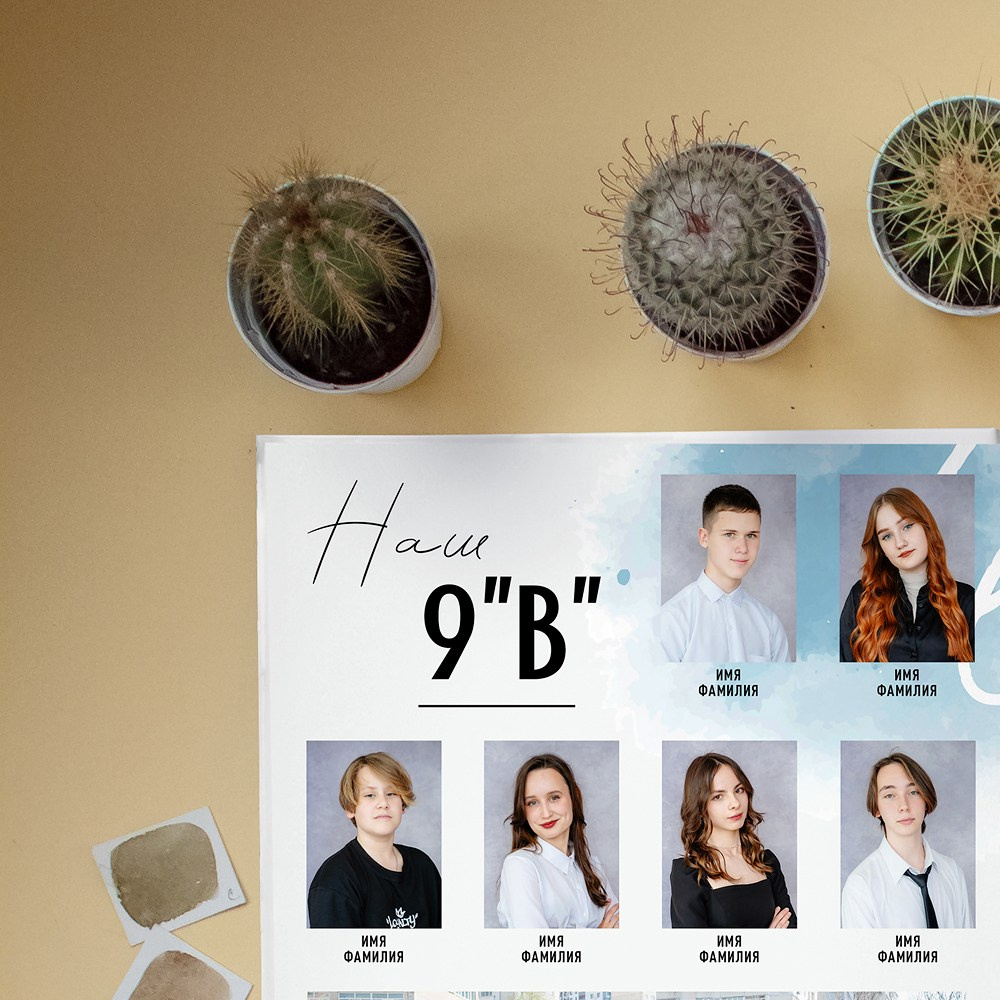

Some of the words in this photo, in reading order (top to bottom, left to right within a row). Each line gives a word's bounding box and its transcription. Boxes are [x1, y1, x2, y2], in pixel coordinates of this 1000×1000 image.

[306, 479, 489, 588] Наш
[716, 668, 741, 681] ИМЯ
[894, 668, 920, 682] ИМЯ
[698, 683, 759, 697] ФАМИЛИЯ
[876, 683, 937, 697] ФАМИЛИЯ
[361, 935, 386, 948] ИМЯ
[539, 935, 564, 948] ИМЯ
[717, 935, 742, 948] ИМЯ
[895, 935, 921, 948] ИМЯ
[343, 950, 404, 963] ФАМИЛИЯ
[521, 950, 582, 963] ФАМИЛИЯ
[699, 950, 760, 963] ФАМИЛИЯ
[877, 950, 938, 963] ФАМИЛИЯ
